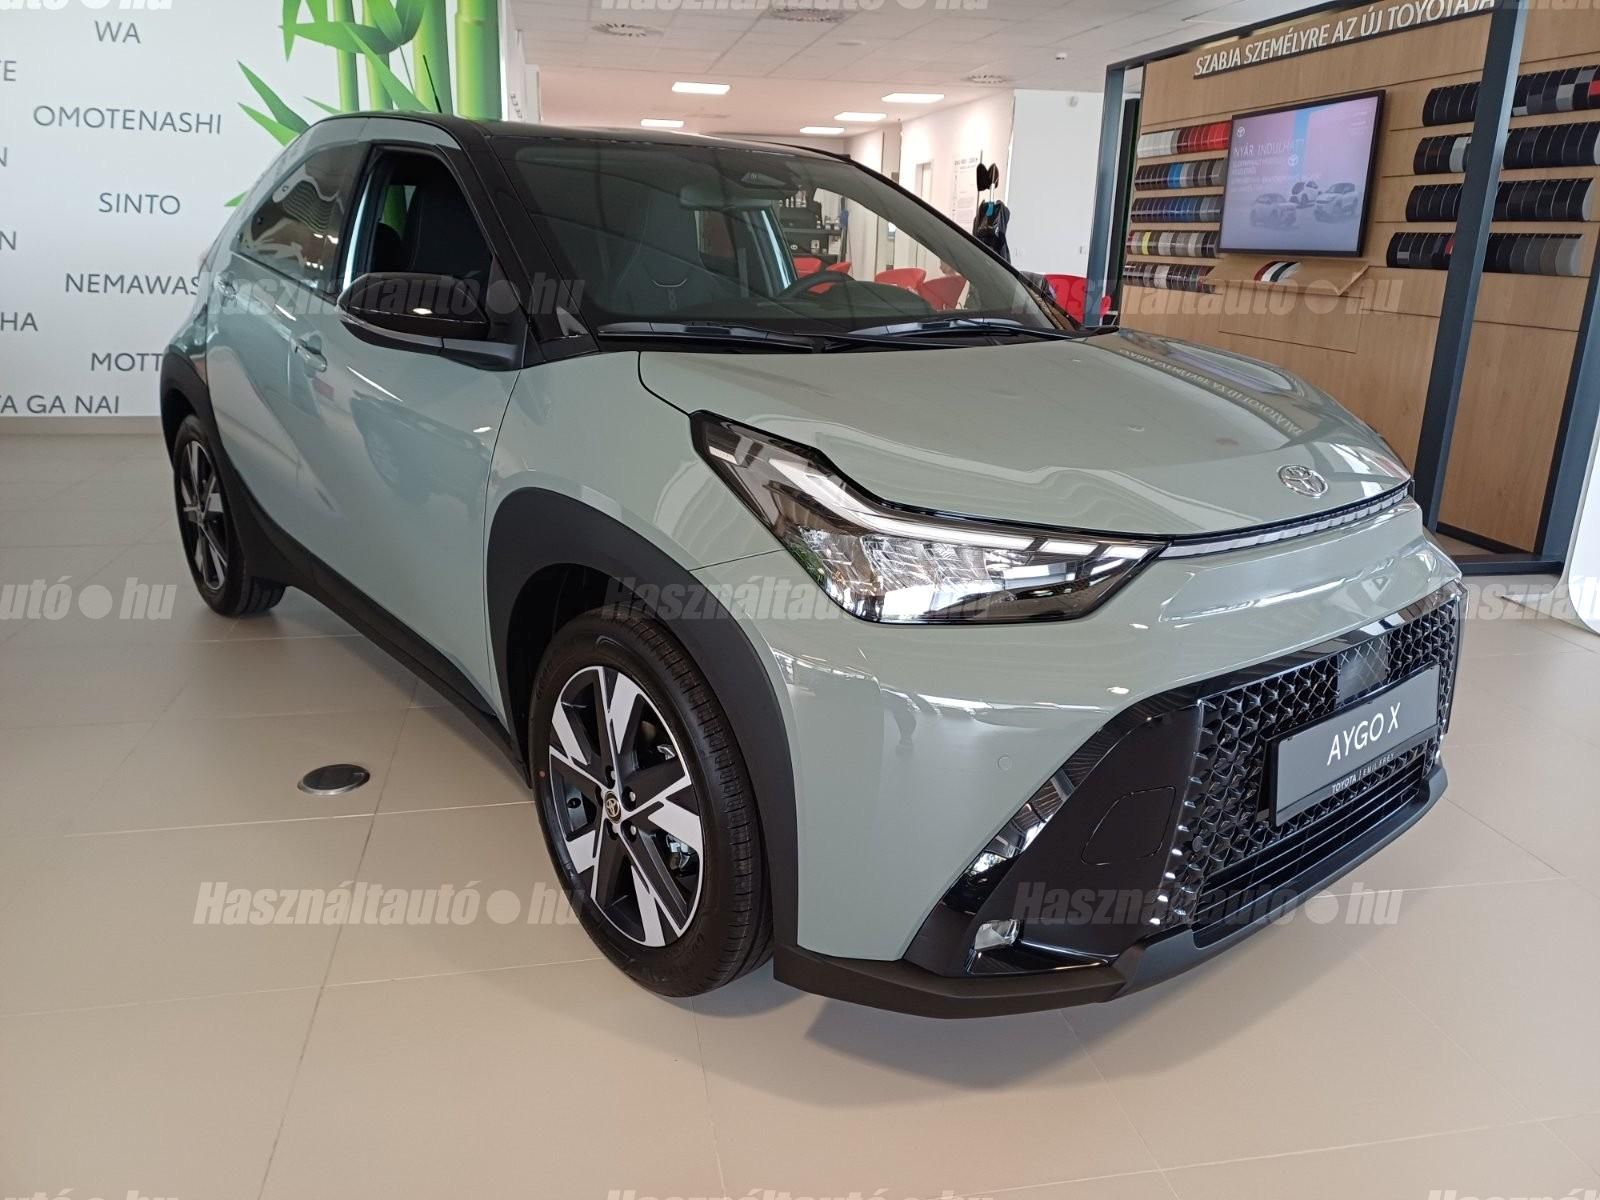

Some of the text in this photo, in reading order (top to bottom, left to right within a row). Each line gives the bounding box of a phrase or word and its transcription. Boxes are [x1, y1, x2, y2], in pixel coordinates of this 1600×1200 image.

[94, 20, 142, 44] WA
[1194, 48, 1241, 76] SZABJA
[1243, 26, 1331, 65] SZEMÉLYRE
[1331, 17, 1356, 44] AZ
[1360, 5, 1382, 37] ÚJ
[33, 105, 222, 135] OMOTENASHI
[99, 192, 181, 215] SINTO
[0, 395, 120, 414] A GA NAI
[1326, 702, 1401, 766] AYGO X
[1331, 774, 1357, 794] TOYOTA
